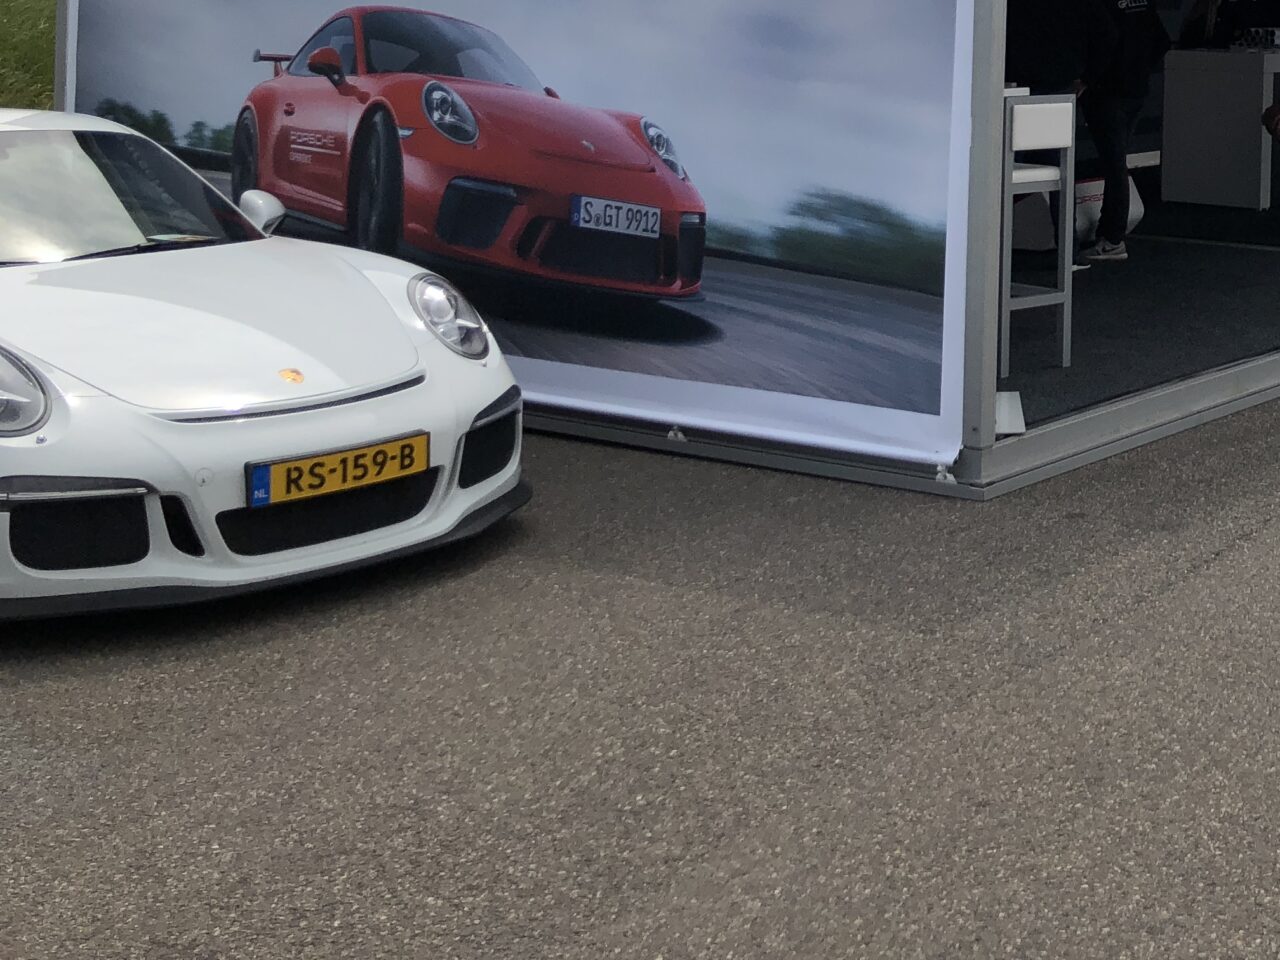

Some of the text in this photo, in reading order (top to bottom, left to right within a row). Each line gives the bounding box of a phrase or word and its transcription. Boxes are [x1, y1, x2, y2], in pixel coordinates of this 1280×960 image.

[582, 201, 594, 224] S
[603, 203, 623, 228] GT
[626, 207, 659, 234] 9912
[254, 443, 416, 499] NL RS-159-B
